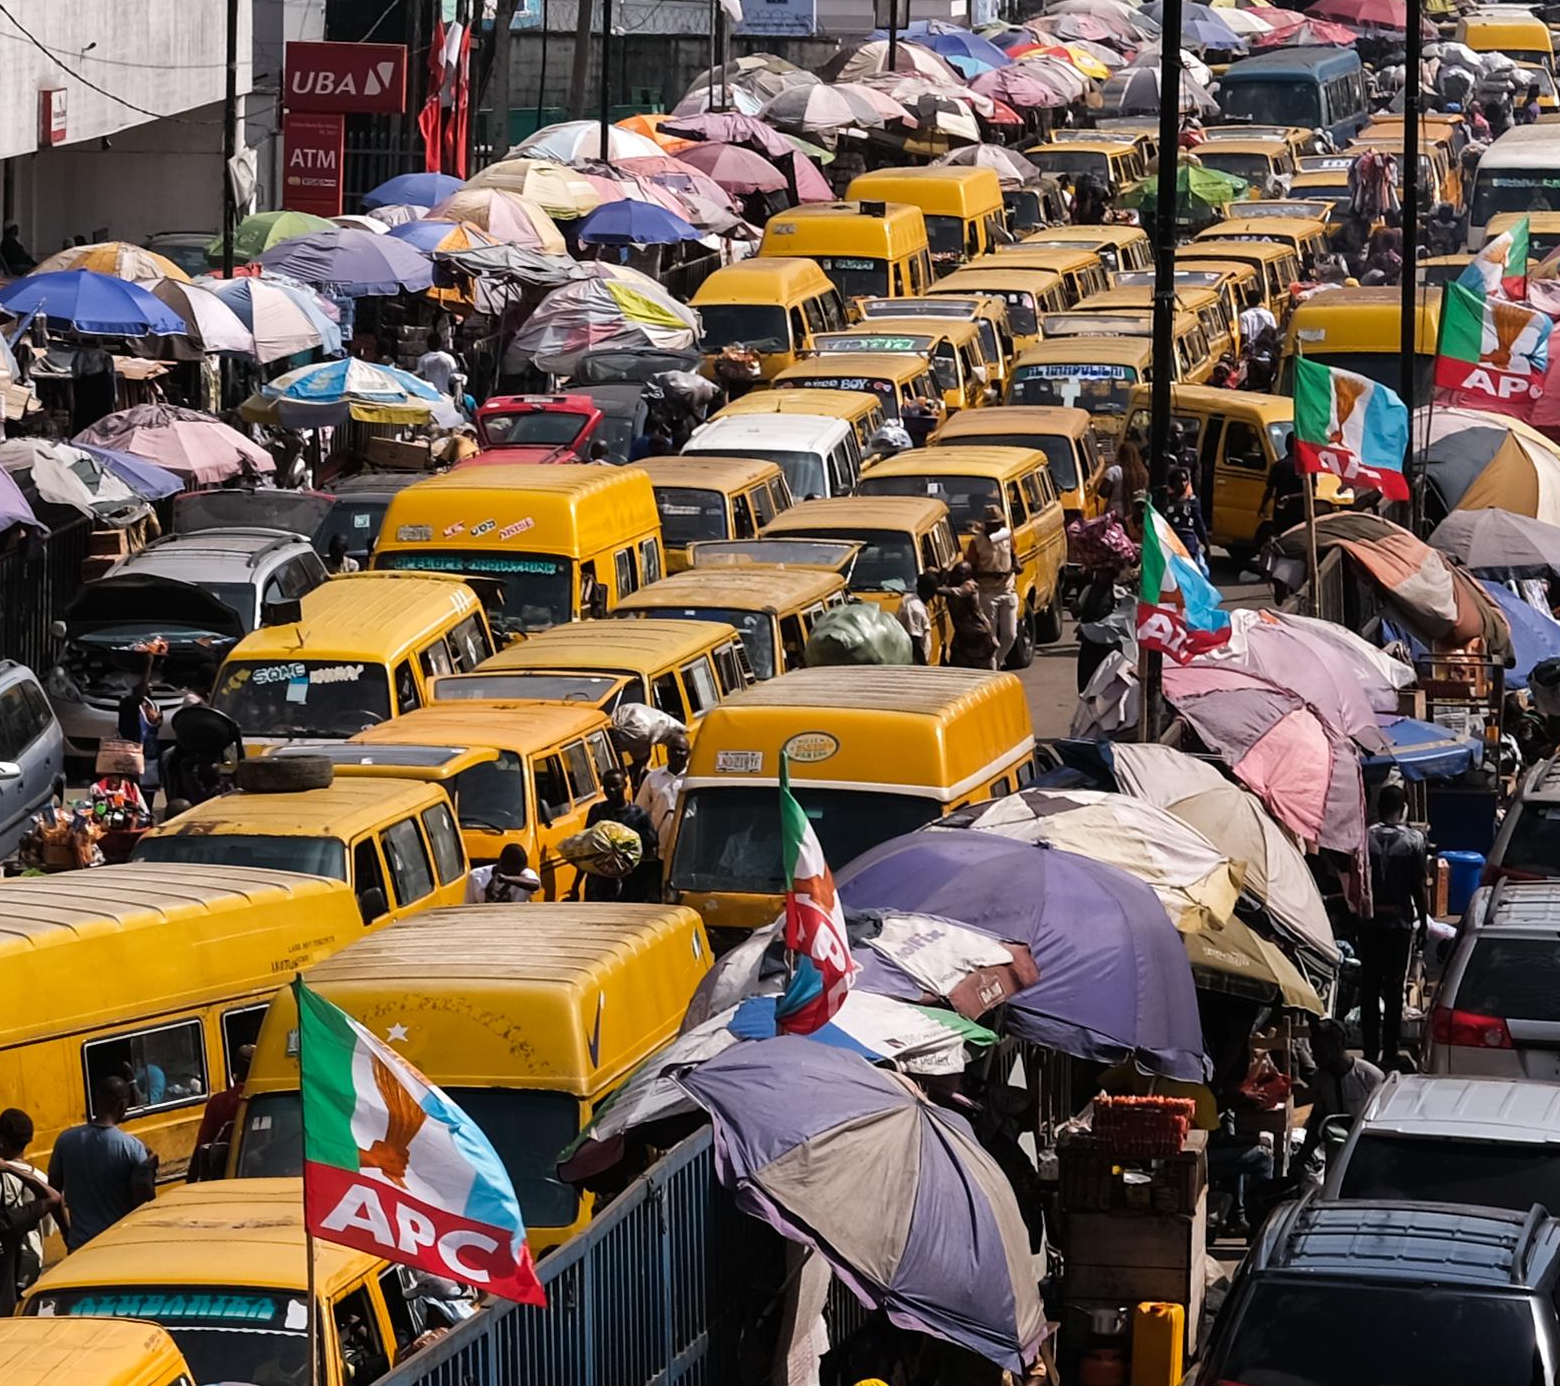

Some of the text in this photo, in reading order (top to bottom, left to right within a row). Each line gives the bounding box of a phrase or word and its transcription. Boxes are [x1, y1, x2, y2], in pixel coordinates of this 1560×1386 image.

[291, 72, 357, 94] UBA
[290, 149, 336, 169] ATM
[841, 378, 869, 390] BOY
[320, 1183, 500, 1284] APC
